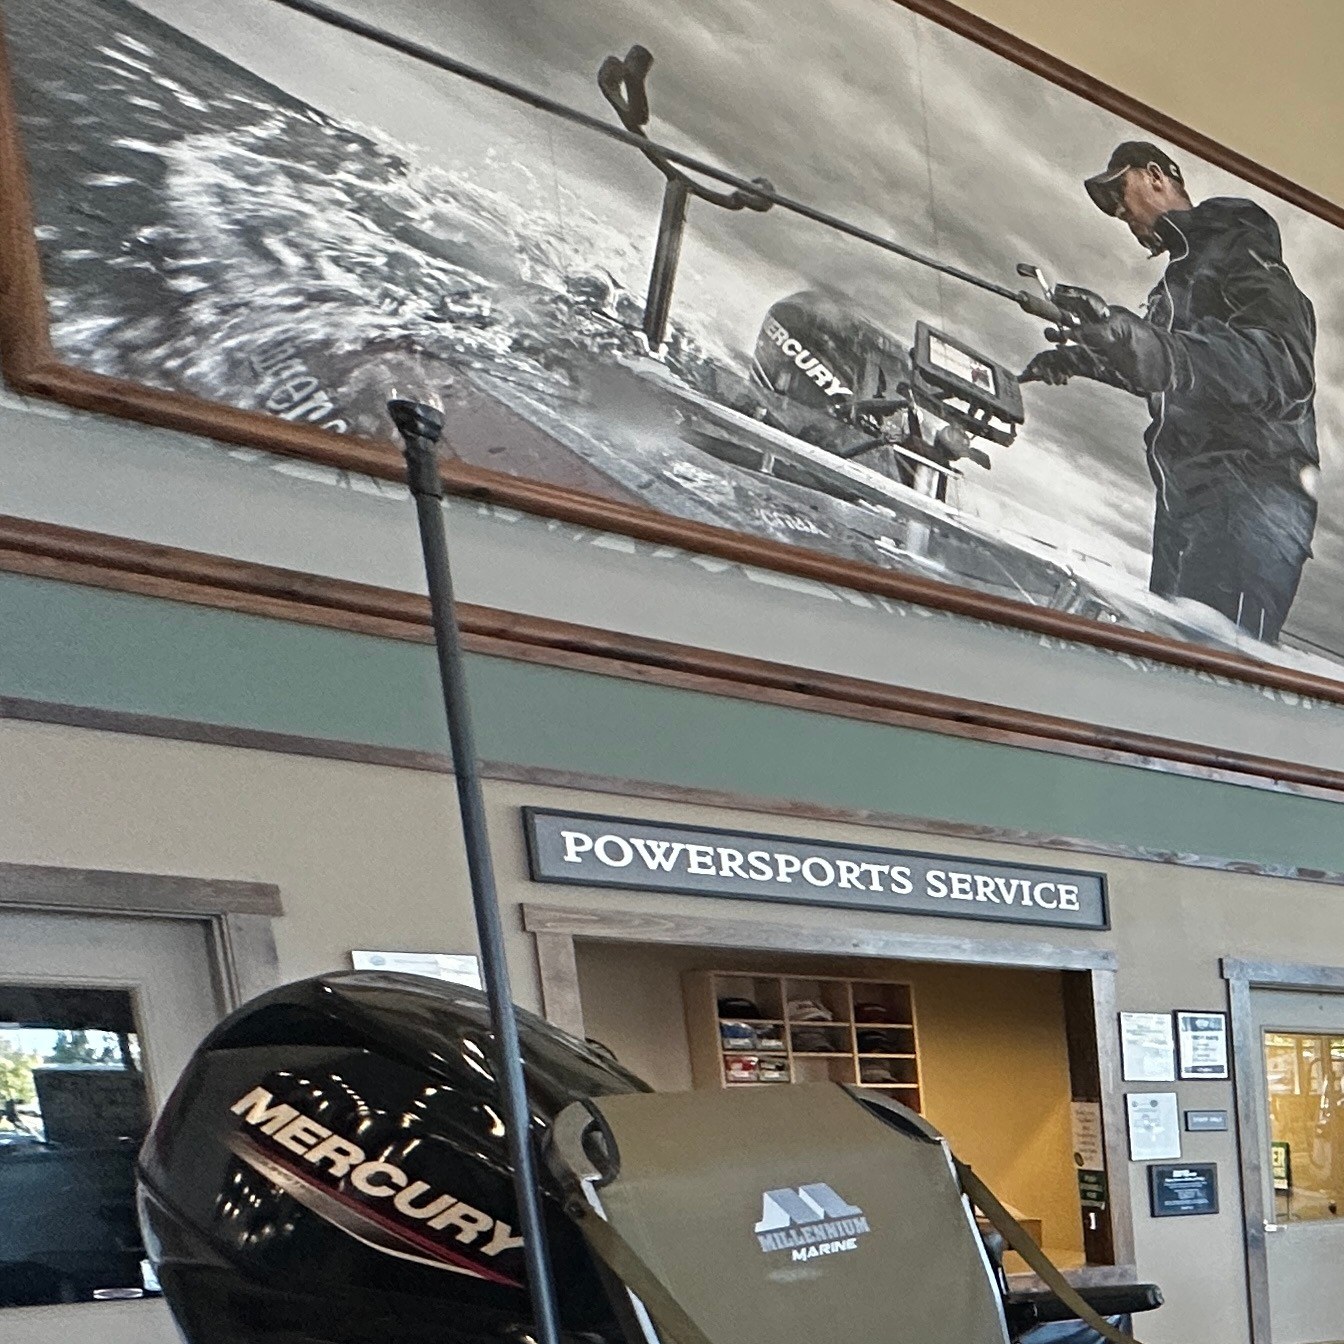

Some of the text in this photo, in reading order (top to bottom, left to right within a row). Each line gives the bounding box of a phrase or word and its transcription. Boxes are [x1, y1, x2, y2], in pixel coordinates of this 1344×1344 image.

[762, 315, 853, 396] ERCURY
[560, 830, 1080, 912] POWERSPORTS SERVICE
[230, 1086, 525, 1257] MERCURY
[756, 1216, 871, 1253] MILLENNIUM
[791, 1237, 858, 1262] MARINE
